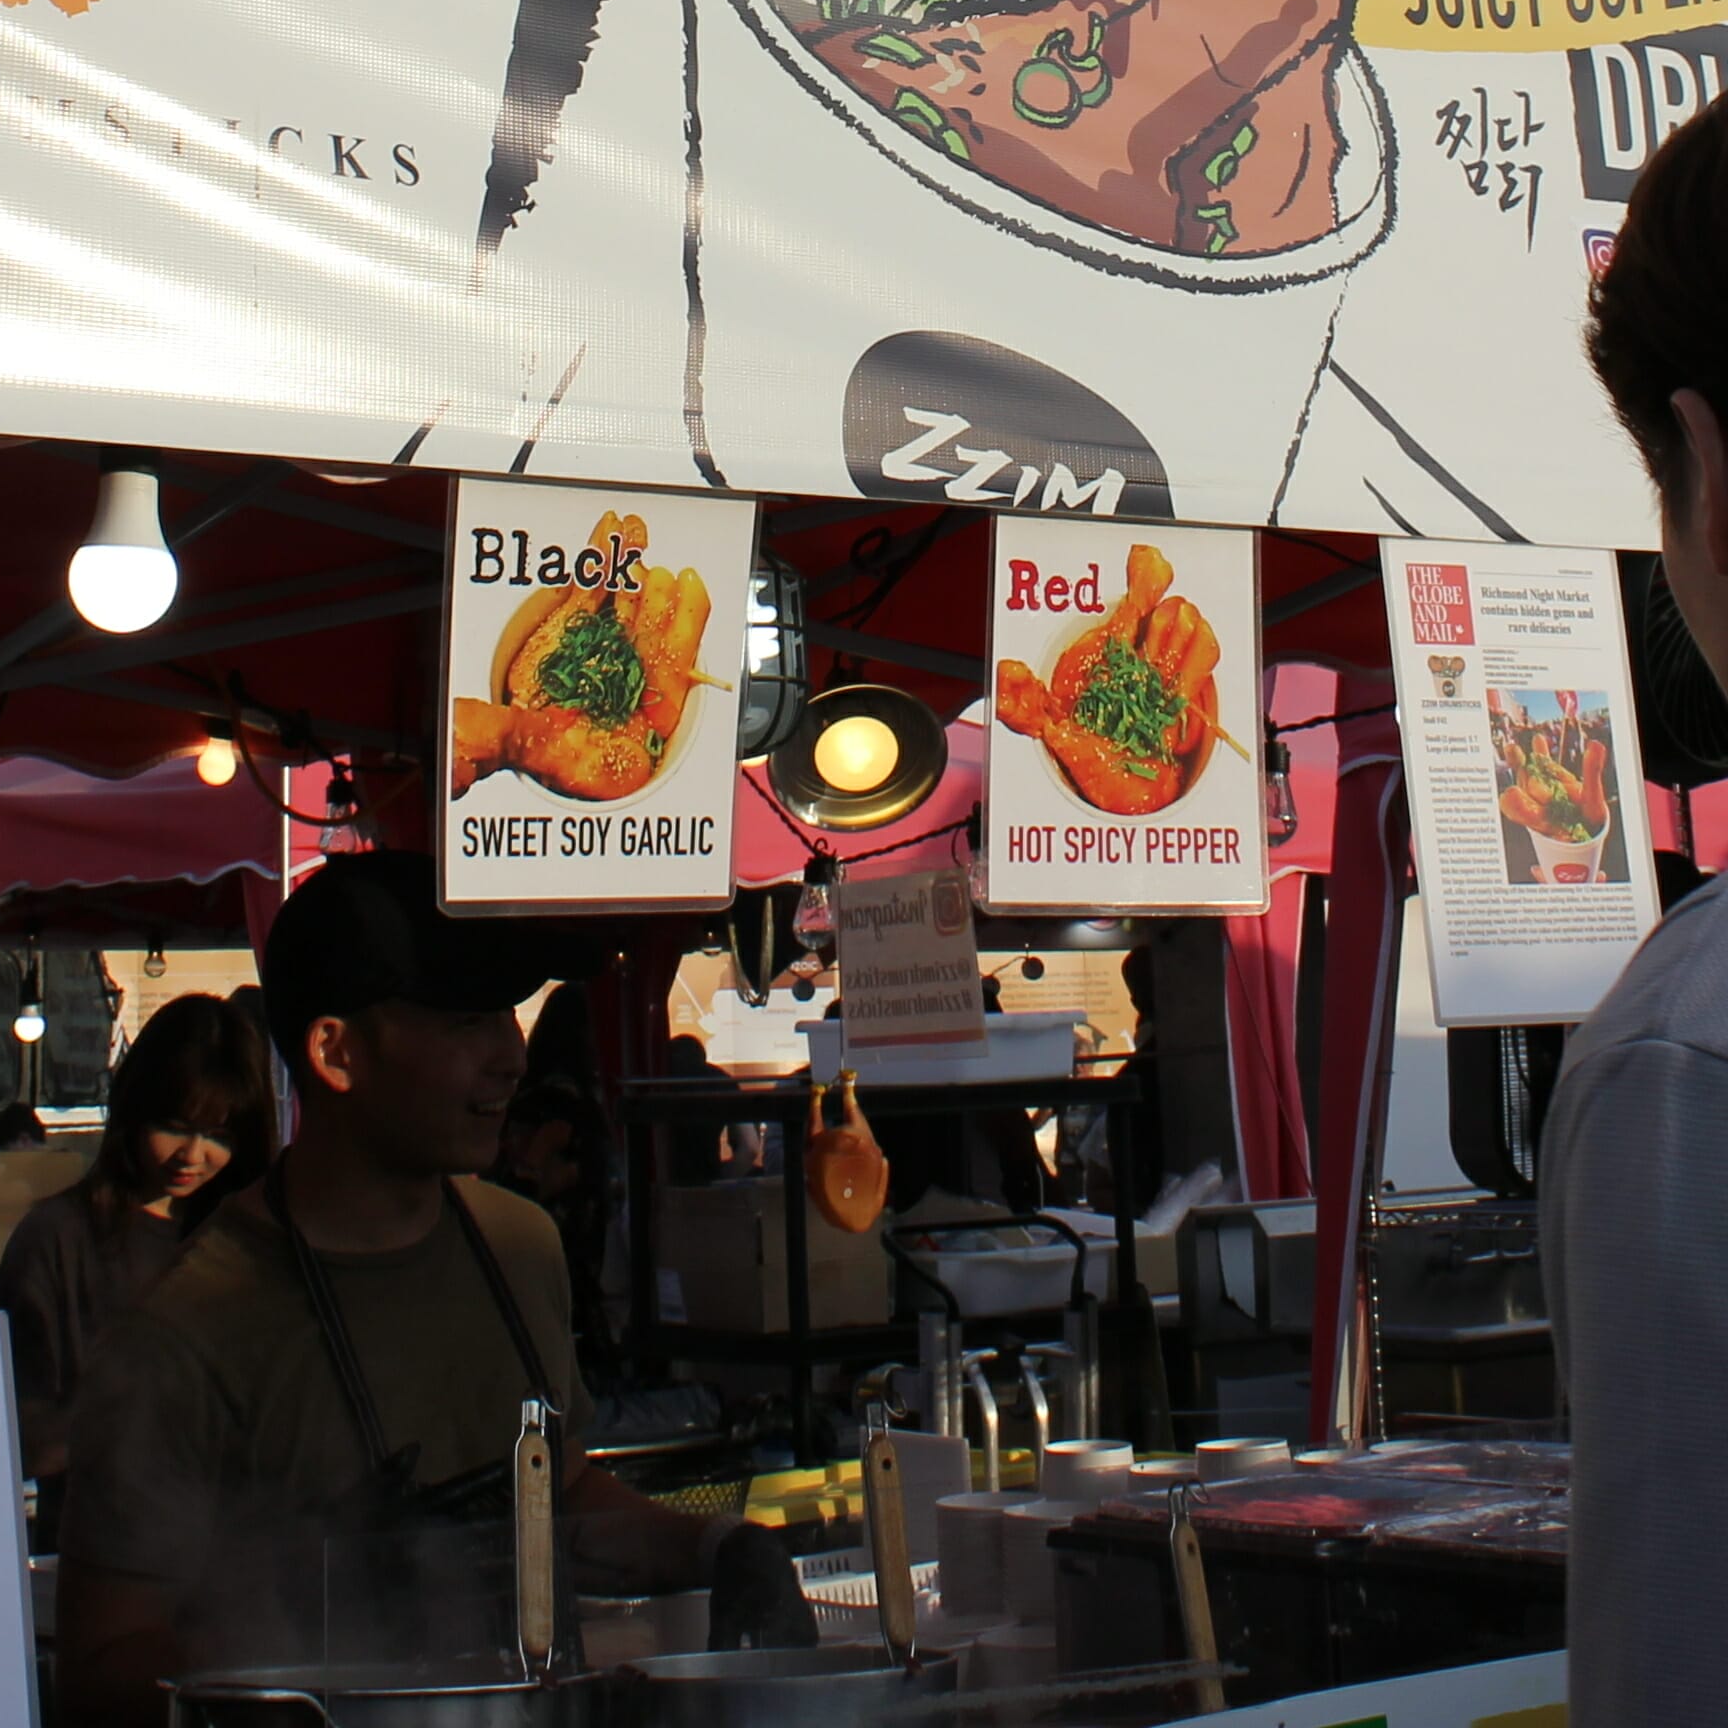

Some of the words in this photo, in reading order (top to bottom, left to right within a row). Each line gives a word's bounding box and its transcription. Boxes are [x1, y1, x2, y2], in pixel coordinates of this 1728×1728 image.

[470, 527, 642, 592] Black
[1407, 565, 1444, 586] THE
[1006, 559, 1106, 615] Red
[1411, 584, 1464, 605] GLOBE
[1480, 586, 1528, 601] Richmond
[1529, 588, 1555, 604] Night
[1556, 589, 1591, 603] Market
[1414, 604, 1448, 623] AND
[1480, 604, 1519, 617] contains
[1520, 605, 1551, 618] hidden
[1552, 608, 1575, 621] gems
[1577, 607, 1594, 619] and
[1416, 623, 1457, 642] MAIL
[1508, 623, 1528, 634] rare
[1529, 622, 1572, 635] delicacies
[462, 816, 553, 859] SWEET
[560, 815, 614, 858] SOY
[619, 815, 715, 858] GARLIC
[1008, 825, 1057, 865] HOT
[1064, 825, 1138, 866] SPICY
[1145, 825, 1242, 865] PEPPER
